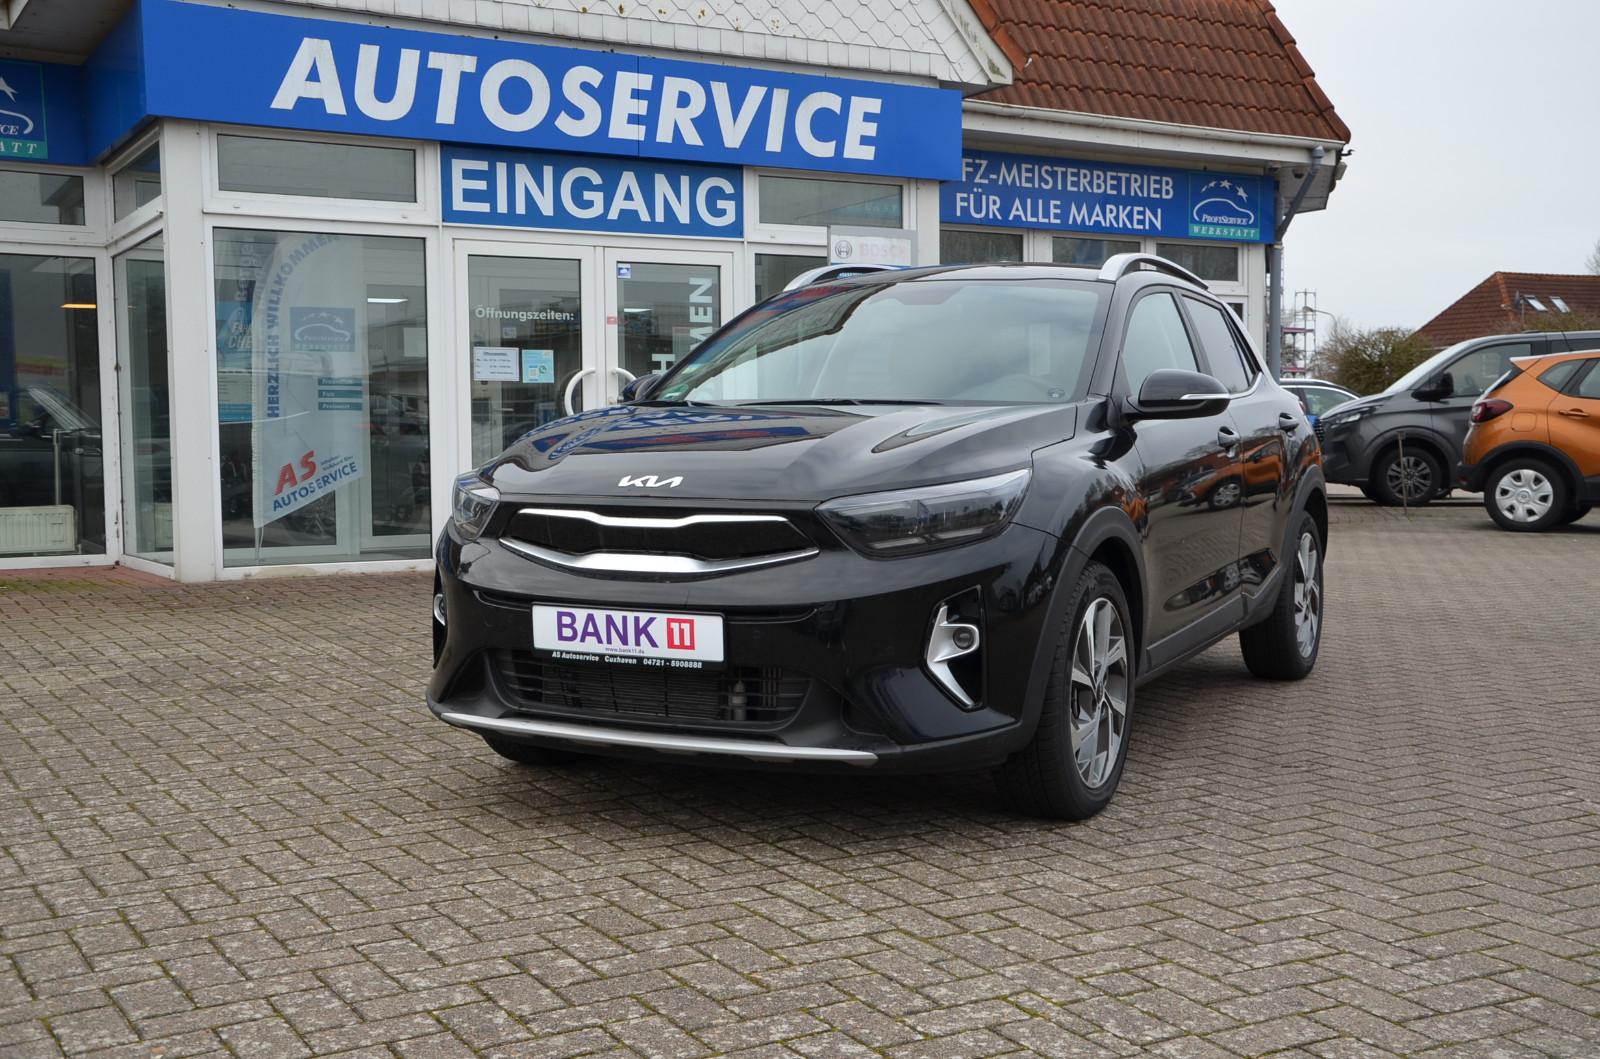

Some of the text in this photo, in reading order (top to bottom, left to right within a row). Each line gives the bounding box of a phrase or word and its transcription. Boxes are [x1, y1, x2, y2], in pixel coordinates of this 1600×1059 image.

[270, 37, 883, 163] AUTOSERVICE
[450, 159, 737, 227] EINGANG
[962, 158, 1174, 199] FZ-MEISTERBETRIEB
[956, 188, 1162, 231] FÜR ALLE MARKEN
[1192, 225, 1257, 238] WERKSTATT
[475, 305, 575, 323] Öffnungszeiten:
[267, 334, 281, 417] HERZLICH
[273, 461, 358, 511] AUTOSERVICE
[274, 449, 317, 496] AS
[556, 611, 693, 649] BANK 11
[562, 652, 599, 662] Autoservice
[604, 655, 637, 665] Cuxhaven
[643, 657, 665, 667] 04721
